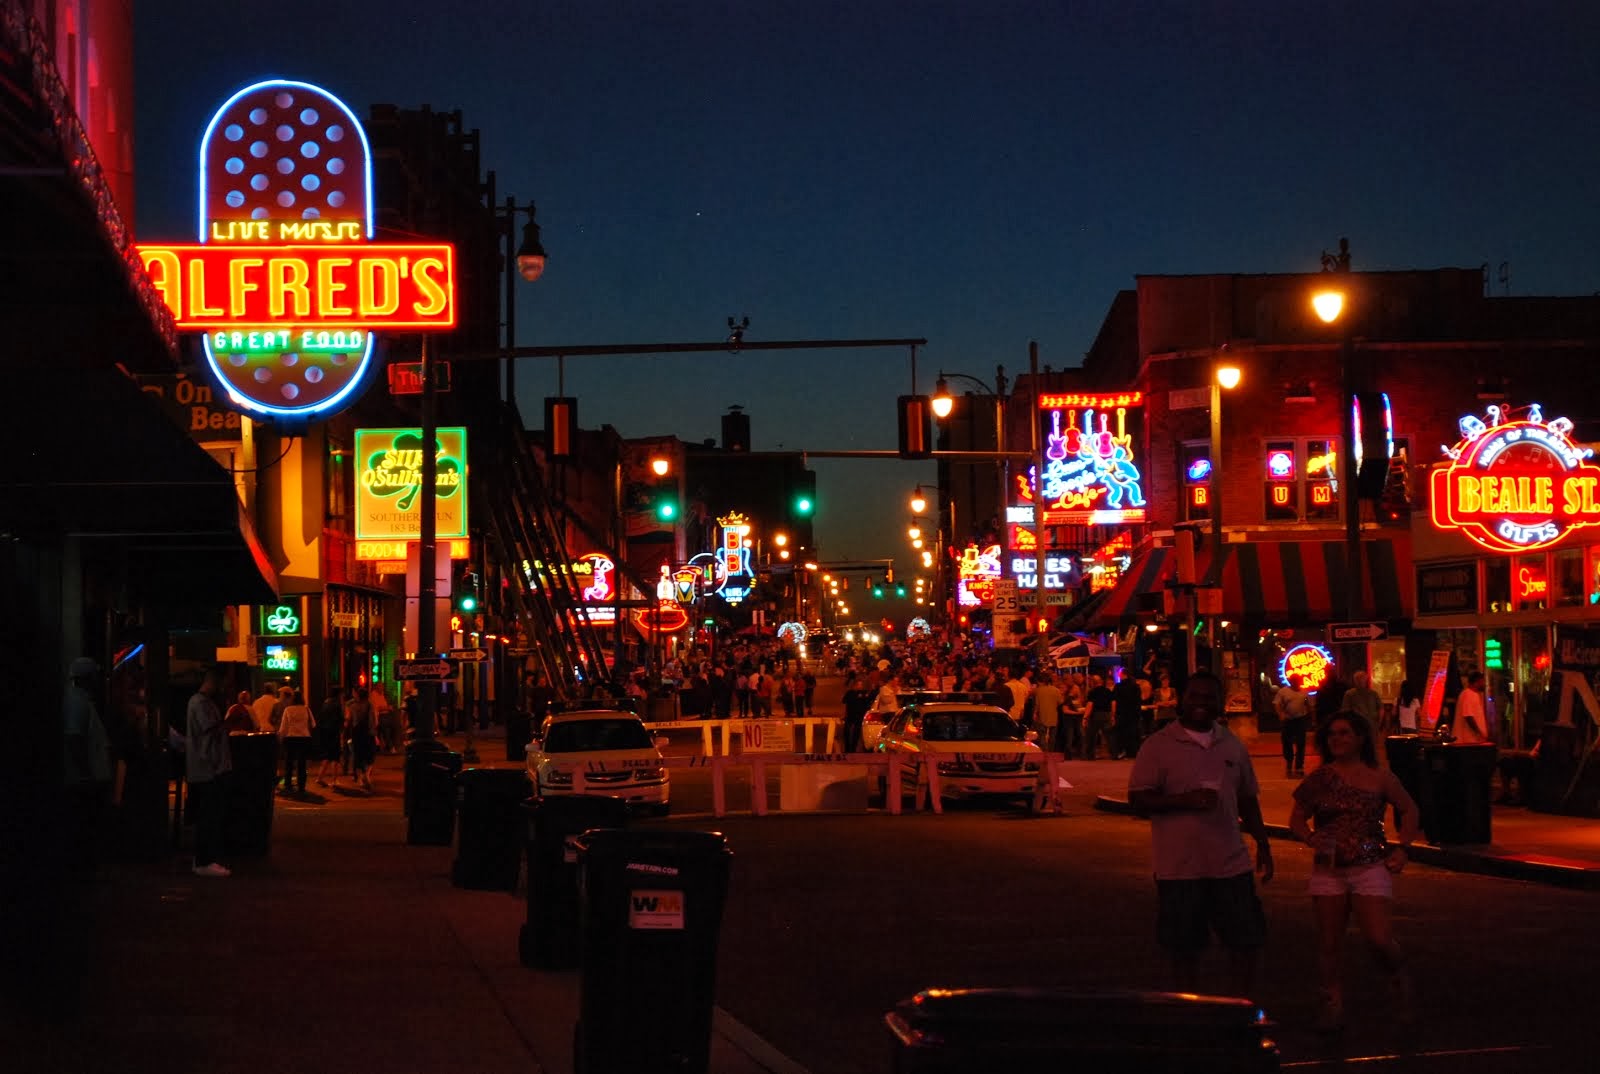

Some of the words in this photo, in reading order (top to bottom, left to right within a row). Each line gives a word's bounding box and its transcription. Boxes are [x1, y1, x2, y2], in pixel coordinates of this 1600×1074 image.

[212, 221, 268, 240] LIVE
[280, 221, 360, 240] MUSIC
[137, 250, 447, 319] ALFRED'S
[214, 331, 290, 349] GREAT
[302, 331, 362, 349] FOOD
[175, 377, 213, 405] On
[361, 466, 460, 487] O'Sullin's
[1457, 476, 1554, 514] BEALE
[369, 512, 424, 522] SOUTHER
[390, 524, 405, 533] 183
[1499, 523, 1559, 543] GIFTS
[996, 597, 1018, 610] 25
[1046, 594, 1067, 604] OINT
[267, 658, 297, 670] COVER
[745, 724, 762, 748] NO
